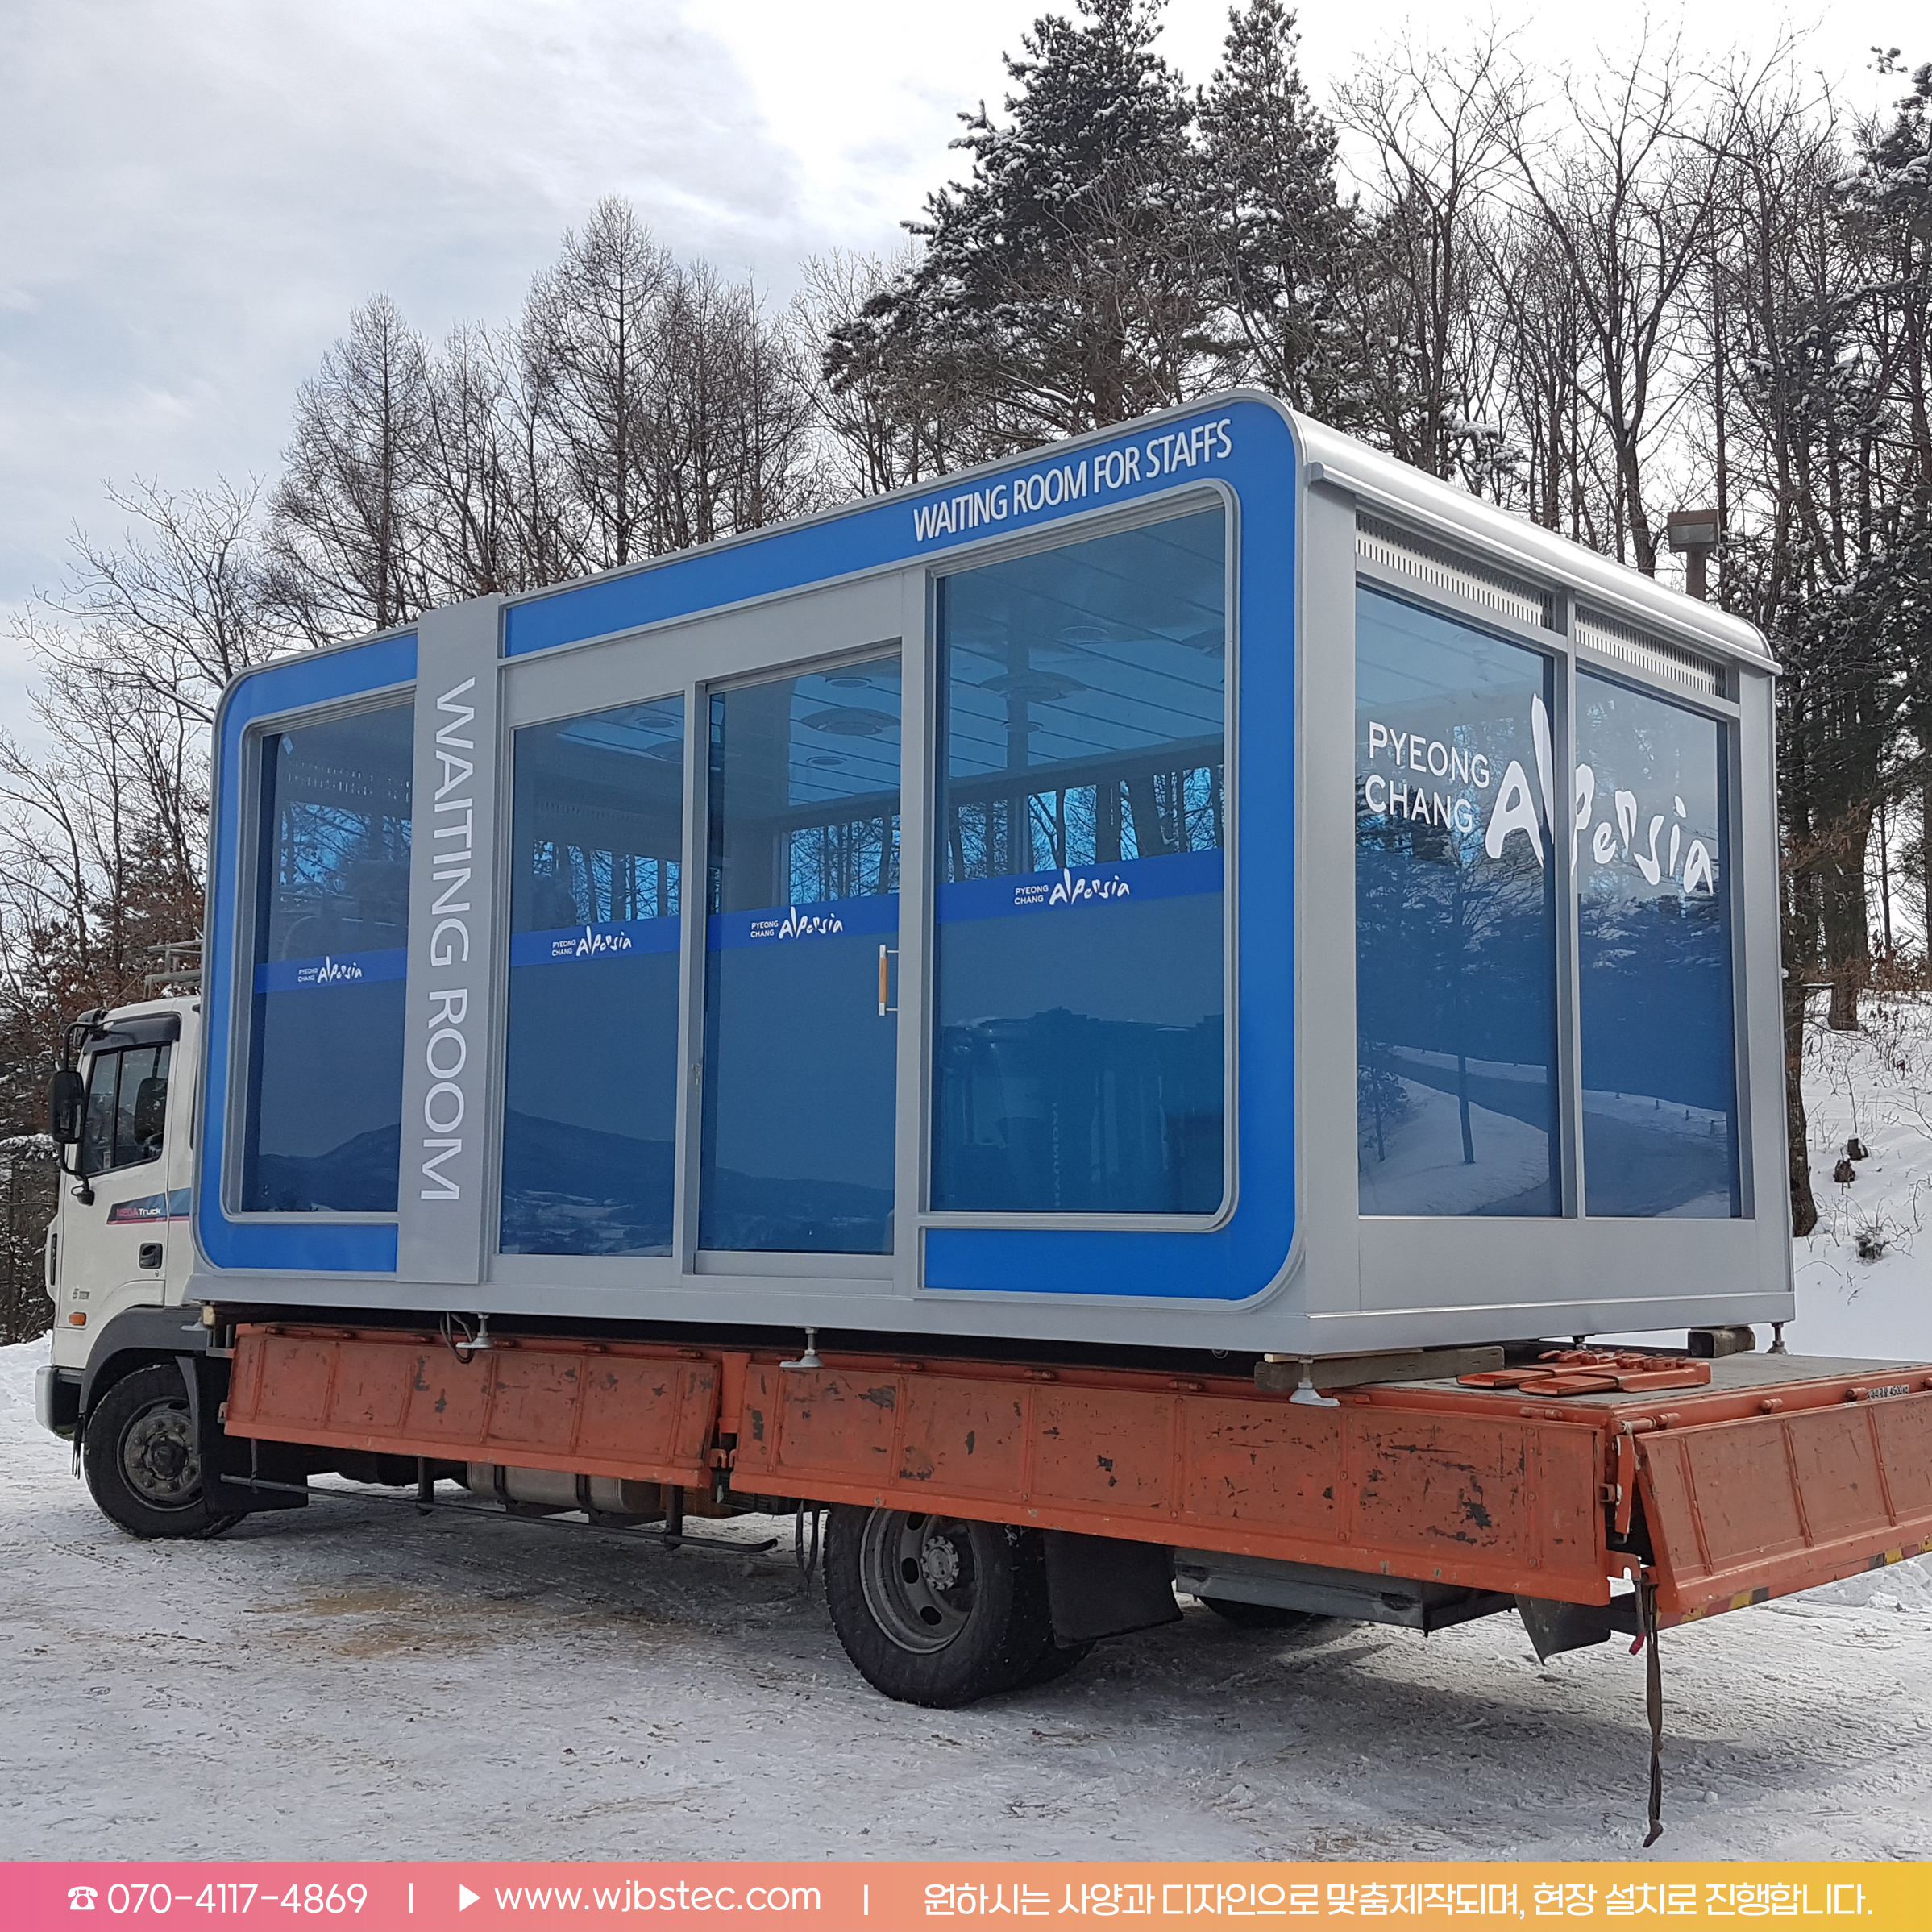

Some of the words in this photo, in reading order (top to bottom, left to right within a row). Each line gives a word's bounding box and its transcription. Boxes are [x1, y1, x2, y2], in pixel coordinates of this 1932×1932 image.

[913, 484, 1008, 542] WAITING
[1012, 460, 1087, 516] ROOM
[1094, 446, 1141, 493] FOR
[1145, 418, 1232, 479] STAFFS
[1369, 721, 1490, 788] PYEONG
[430, 676, 476, 966] WAITING
[1365, 775, 1473, 833] CHANG
[1014, 895, 1044, 905] CHANG
[1015, 884, 1049, 896] PYEONG
[750, 929, 775, 938] CHANG
[751, 920, 779, 930] PYEONG
[420, 988, 468, 1200] ROOM
